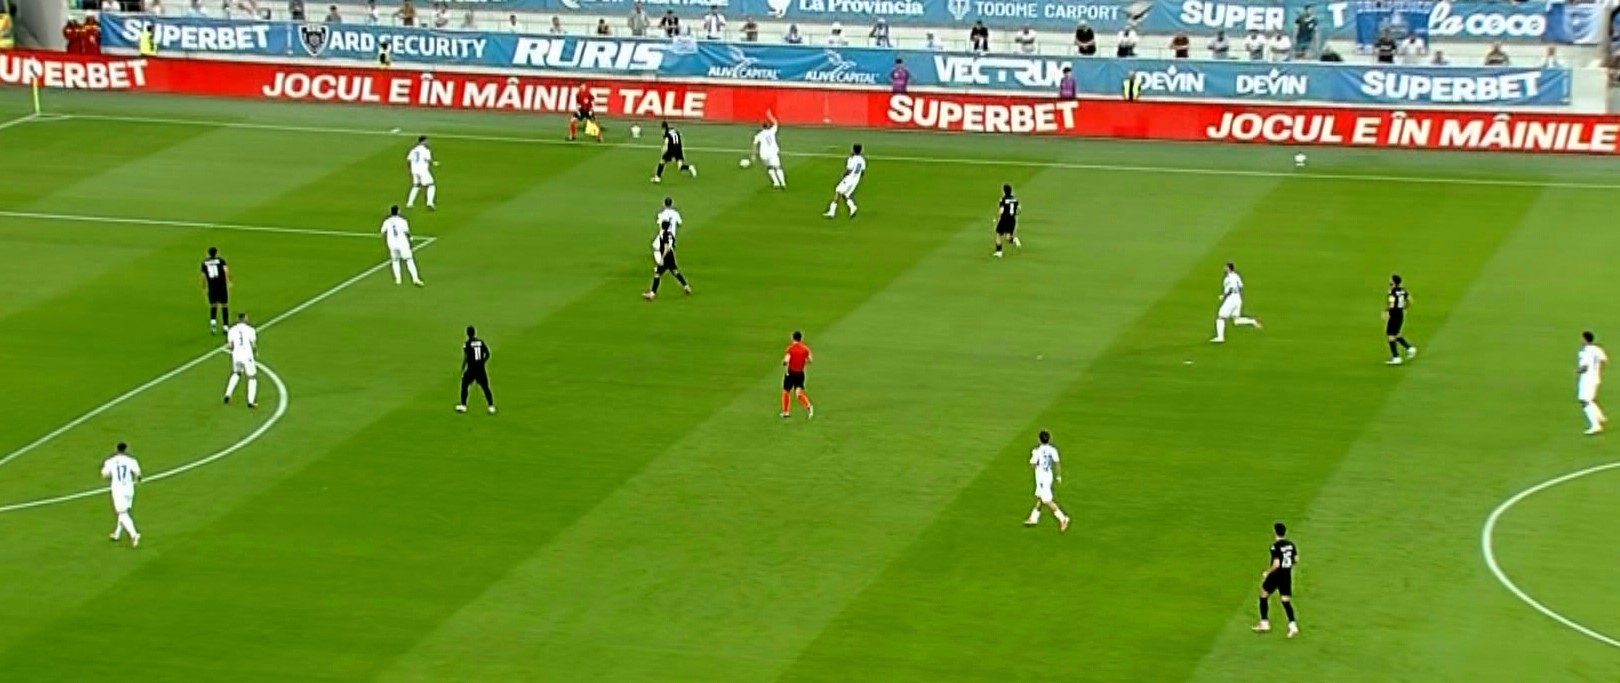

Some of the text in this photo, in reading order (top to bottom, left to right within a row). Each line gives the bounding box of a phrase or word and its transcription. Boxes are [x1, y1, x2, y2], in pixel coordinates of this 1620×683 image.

[829, 0, 924, 15] Provincia
[975, 1, 1119, 20] TODOME CARPORT
[1180, 0, 1348, 30] SUPERT
[122, 19, 269, 49] SUPERBET
[512, 37, 671, 71] RURIS
[263, 72, 381, 101] JOCUL
[389, 78, 413, 103] E
[419, 73, 455, 107] ÎN
[619, 88, 707, 118] TALE
[1136, 70, 1206, 92] DEVIN
[1236, 73, 1306, 95] DEVIN
[1361, 70, 1541, 102] SUPERBET
[887, 94, 1079, 132] SUPERBET
[1207, 111, 1619, 151] JOCUL E ÎN MÂINILE
[117, 464, 128, 482] 17
